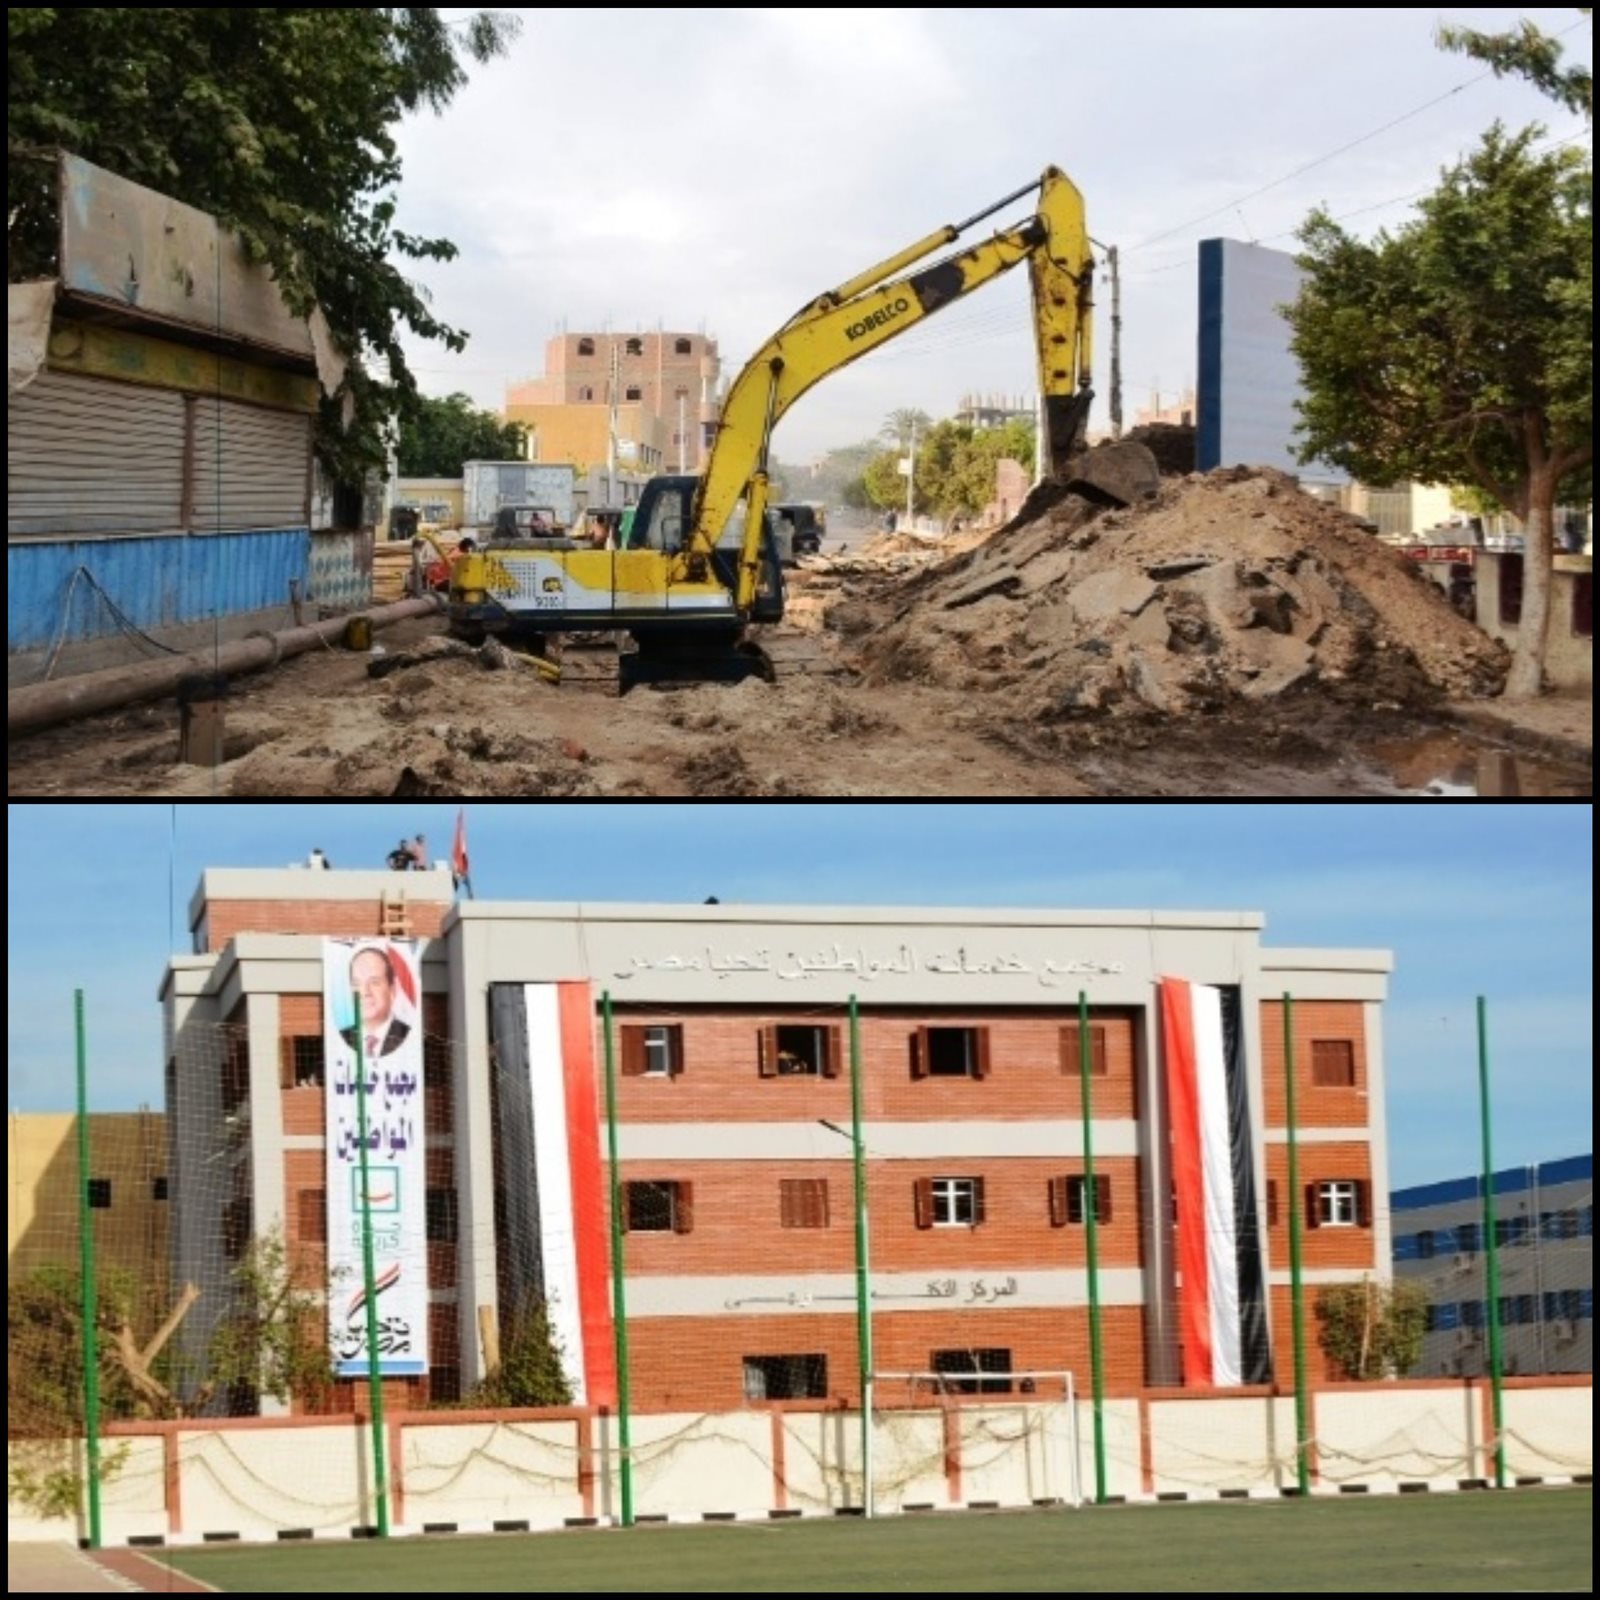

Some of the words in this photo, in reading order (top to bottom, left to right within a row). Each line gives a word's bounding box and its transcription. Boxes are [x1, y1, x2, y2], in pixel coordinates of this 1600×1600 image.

[844, 298, 909, 341] KOBELCO
[612, 956, 702, 980] مصر
[706, 945, 770, 980] تحيا
[775, 944, 916, 981] المواطنين
[924, 946, 1032, 975] خدمات
[1037, 957, 1125, 988] مجمع
[963, 1277, 1018, 1303] المركز
